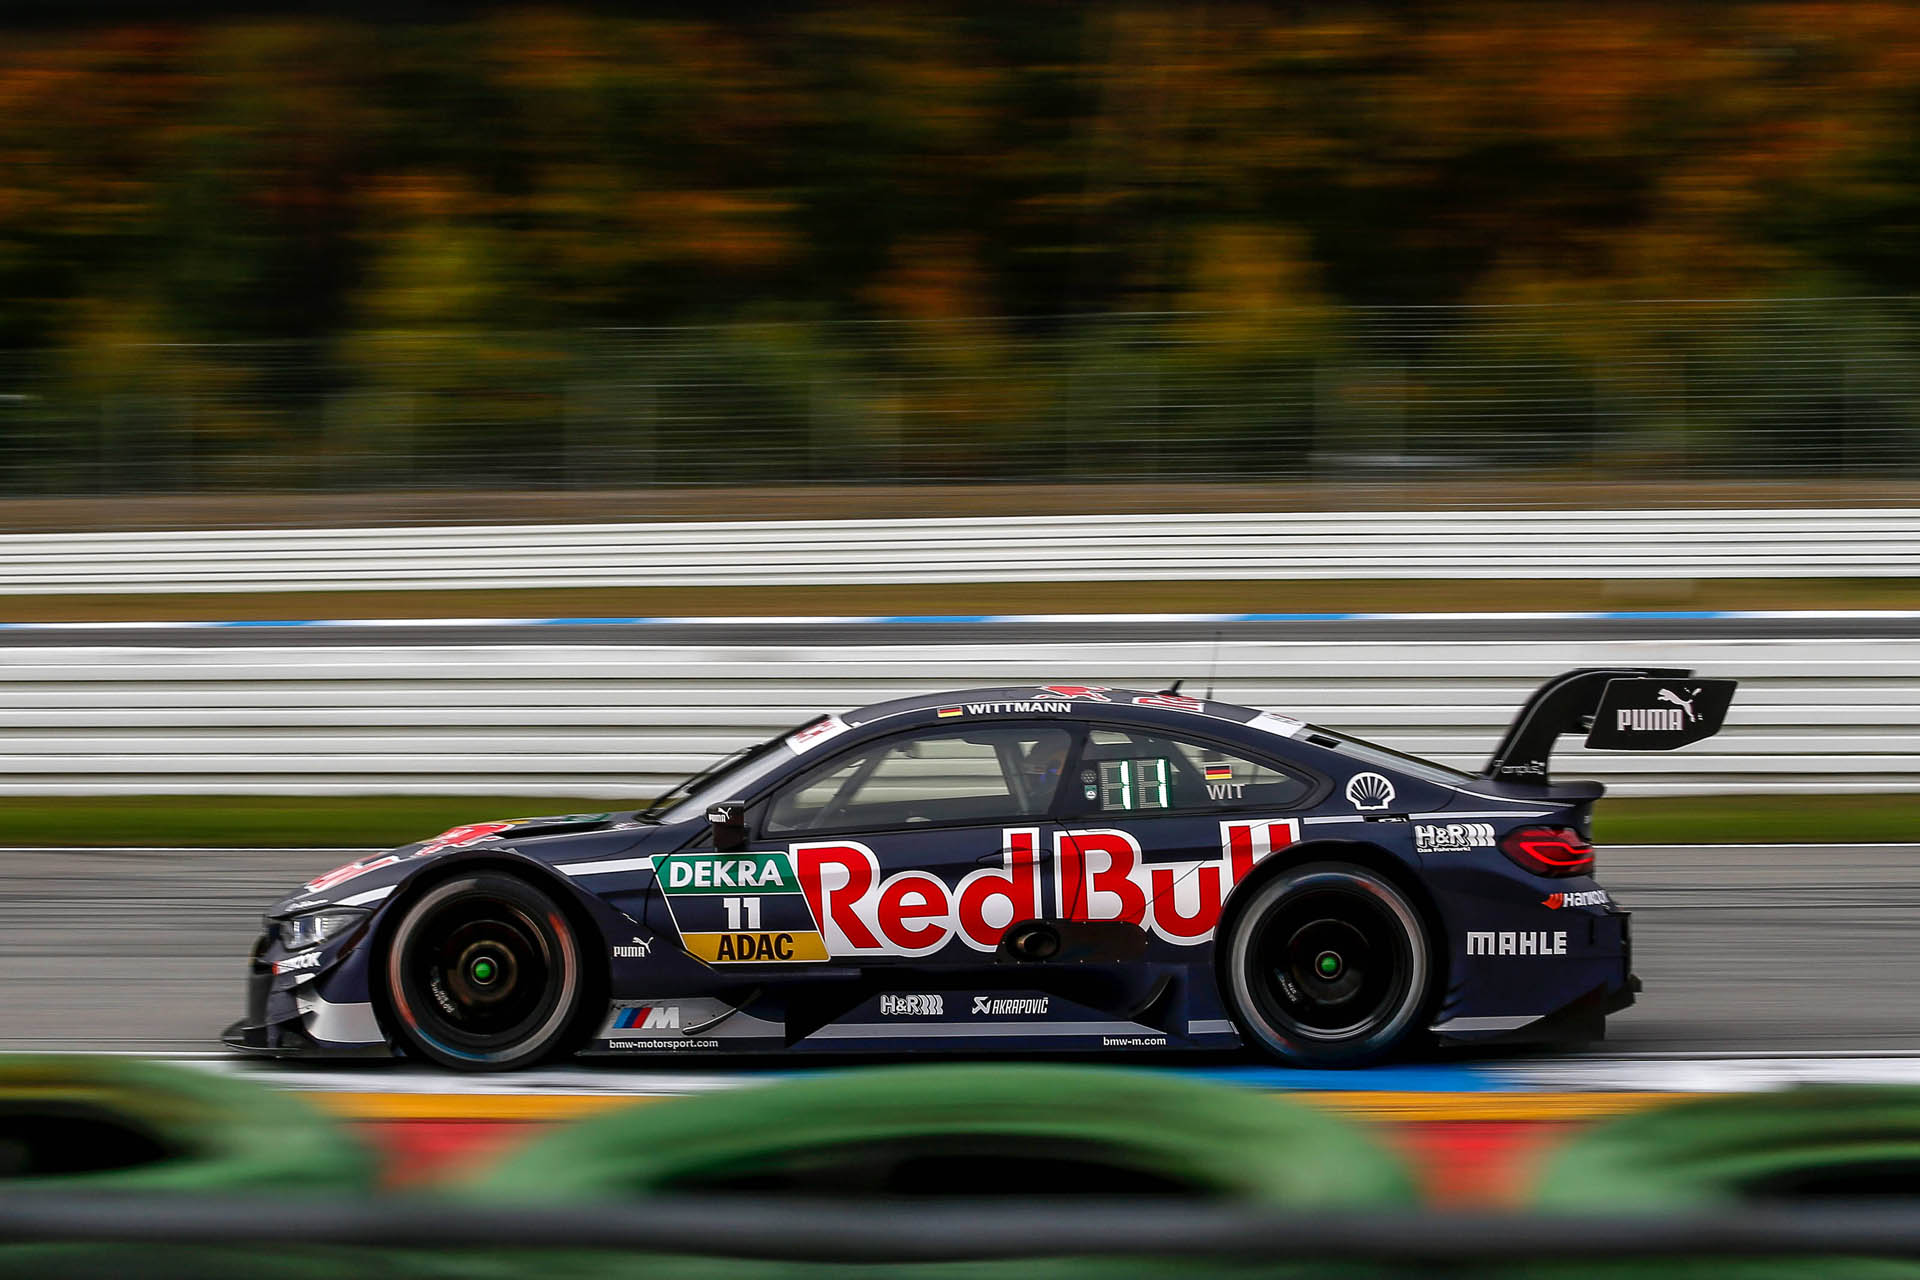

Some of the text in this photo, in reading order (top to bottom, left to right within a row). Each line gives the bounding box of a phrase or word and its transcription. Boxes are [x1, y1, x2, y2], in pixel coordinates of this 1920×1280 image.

[967, 701, 1071, 715] WITTMANN
[1617, 709, 1683, 730] PUMA
[1119, 758, 1169, 810] 11
[1206, 784, 1245, 800] WIT
[1414, 823, 1470, 848] H&R
[669, 859, 784, 888] DEKRA
[790, 828, 1041, 957] Red
[723, 897, 761, 930] 11
[613, 946, 645, 958] PUMA
[717, 933, 794, 960] ADAC
[1467, 931, 1567, 955] MAHLE
[880, 994, 923, 1015] H&R
[609, 1039, 719, 1050] bmw-motorsport.com
[1103, 1036, 1166, 1046] bmw-m.com
